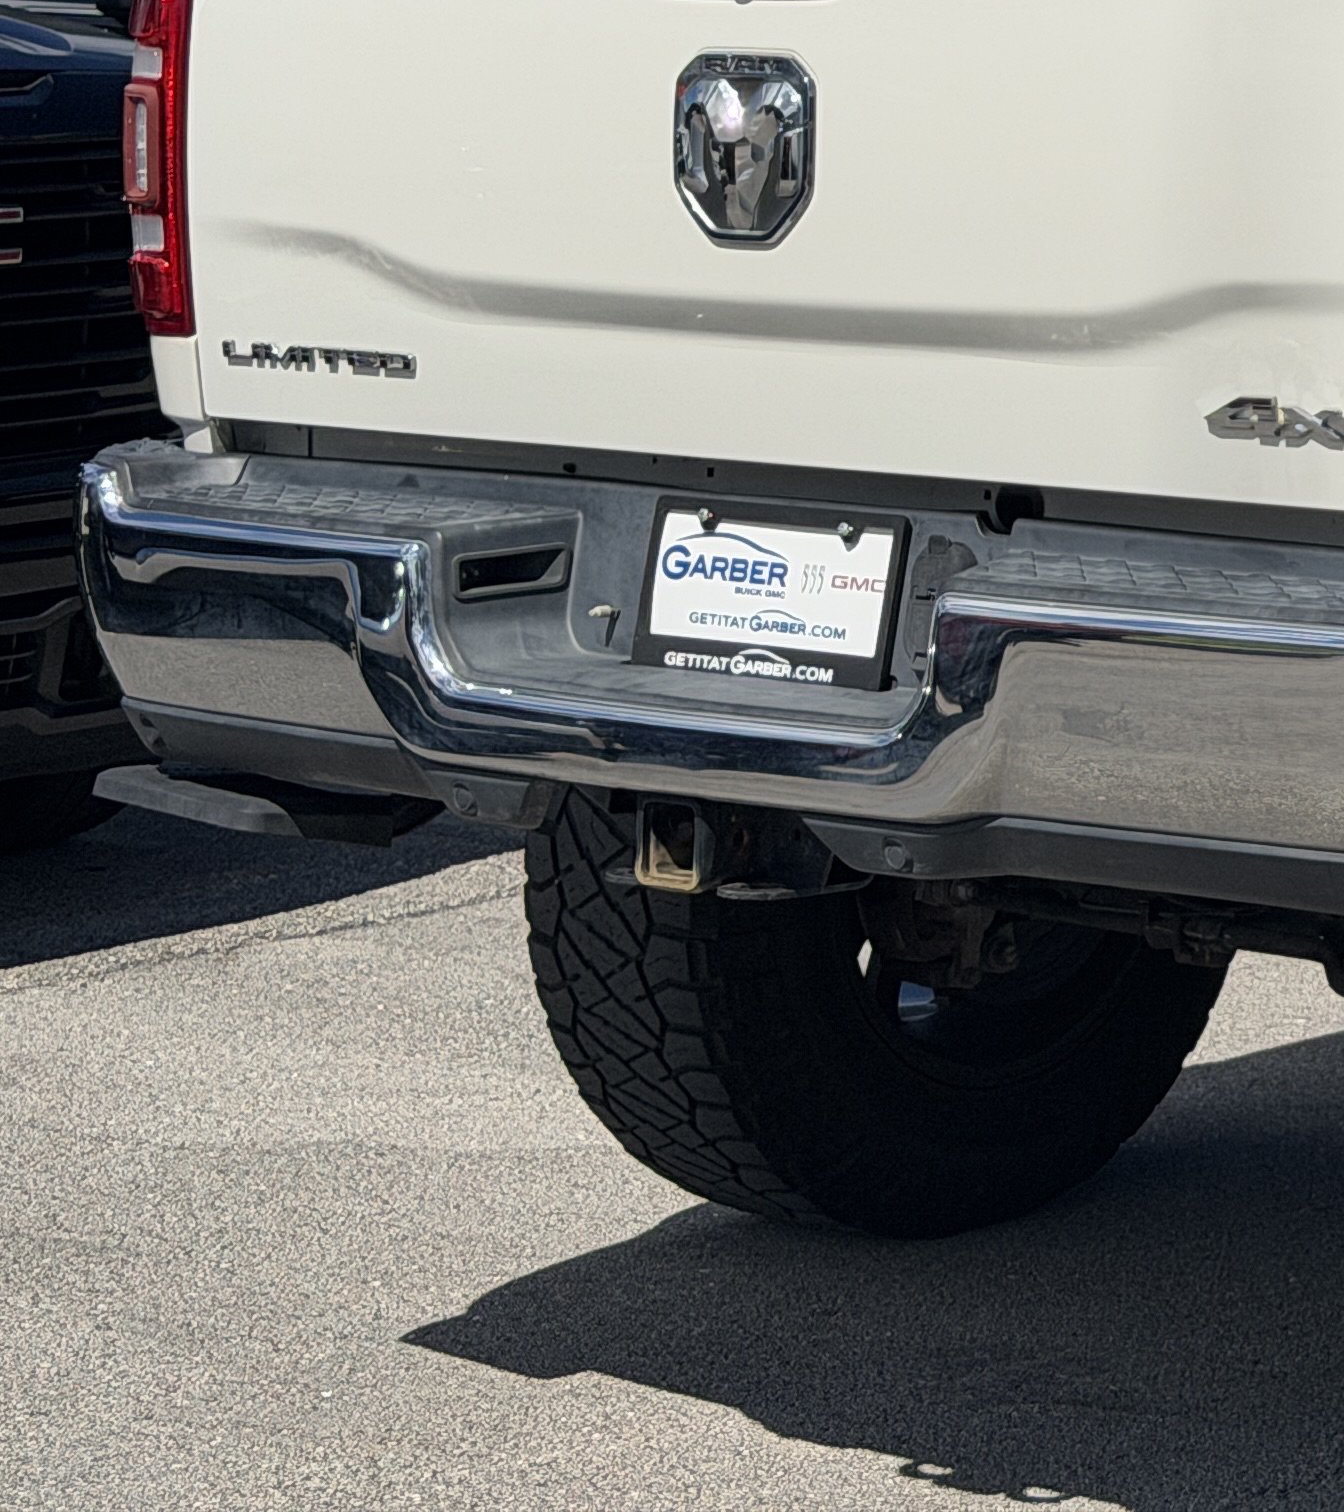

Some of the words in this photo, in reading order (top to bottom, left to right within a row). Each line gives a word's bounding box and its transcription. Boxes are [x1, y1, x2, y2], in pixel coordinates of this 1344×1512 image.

[221, 339, 417, 380] LIMITED
[661, 544, 790, 588] GARBER
[734, 586, 762, 597] BUICK
[765, 588, 786, 600] GMC
[830, 574, 887, 594] GMC
